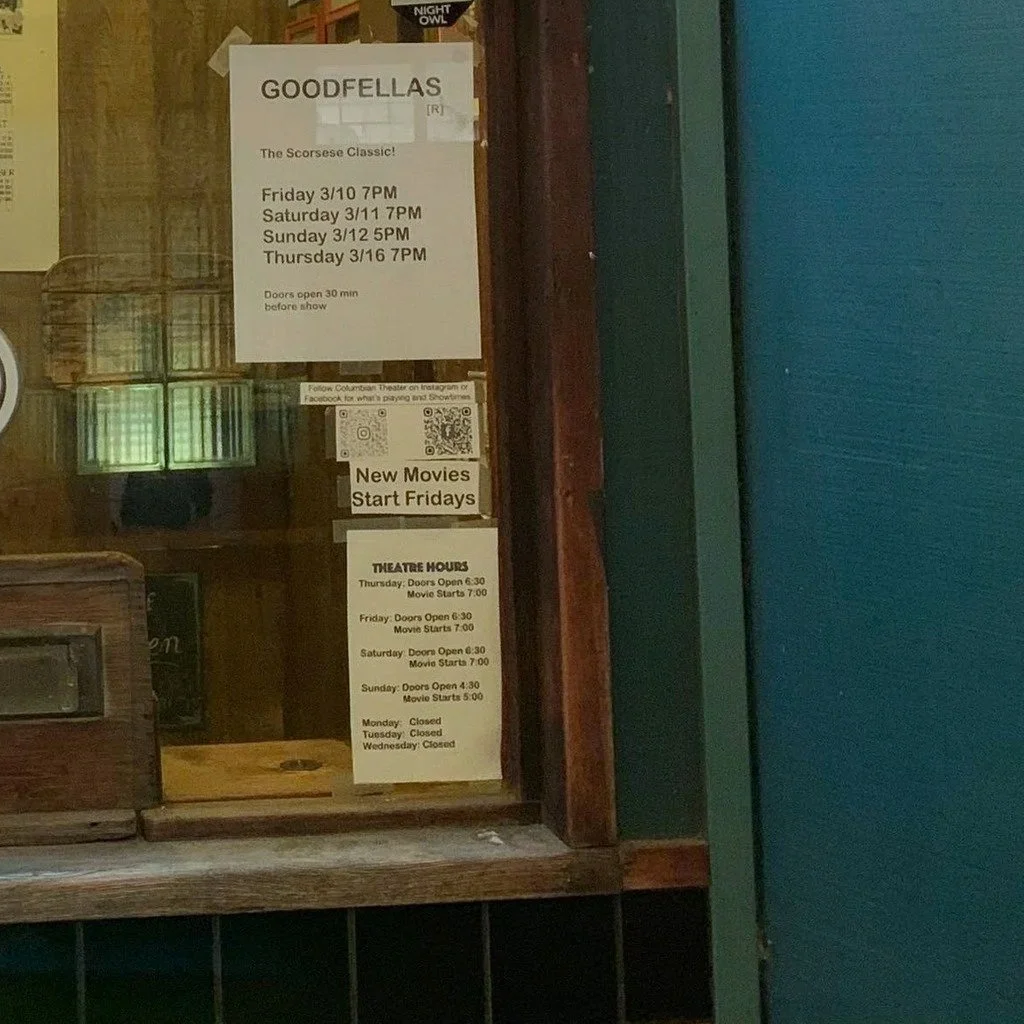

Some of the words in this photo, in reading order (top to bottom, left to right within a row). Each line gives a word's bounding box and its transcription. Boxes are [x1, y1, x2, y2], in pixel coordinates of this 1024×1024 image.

[414, 5, 451, 15] NIGHT
[419, 15, 447, 25] OWL
[261, 77, 441, 99] GOODFELLAS
[261, 147, 283, 158] The
[286, 147, 343, 158] Scorsese
[347, 146, 395, 157] Classic!
[262, 188, 315, 204] Friday
[320, 187, 356, 201] 3/10
[362, 186, 397, 200] 7PM
[263, 208, 339, 225] Saturday
[344, 207, 380, 222] 3/11
[386, 206, 421, 220] 7PM
[263, 229, 327, 245] Sunday
[333, 228, 368, 243] 3/12
[374, 227, 410, 241] 5PM
[263, 250, 344, 267] Thursday
[349, 249, 385, 263] 3/16
[391, 247, 427, 262] 7PM
[264, 290, 295, 299] Doors
[297, 291, 323, 301] open
[325, 289, 337, 298] 30
[340, 289, 359, 297] min
[265, 302, 297, 311] before
[300, 302, 327, 310] show
[335, 384, 376, 392] Columbian
[421, 384, 458, 392] Instagram
[385, 394, 410, 403] playing
[356, 467, 397, 483] New
[404, 466, 470, 482] Movies
[352, 492, 399, 507] Start
[405, 490, 475, 509] Fridays
[372, 563, 424, 573] THEATRE
[427, 562, 468, 572] HOURS
[359, 579, 405, 589] Thursday:
[408, 579, 435, 587] Doors
[438, 578, 463, 587] Open
[465, 577, 485, 585] 6:30
[407, 590, 434, 598] Movie
[437, 589, 465, 598] Starts
[467, 589, 487, 597] 7:00
[394, 613, 422, 622] Doors
[425, 613, 450, 622] Open
[452, 612, 472, 620] 6:30
[394, 625, 421, 634] Movie
[424, 624, 452, 633] Starts
[454, 624, 474, 632] 7:00
[408, 648, 436, 657] Doors
[438, 647, 463, 657] Open
[465, 646, 485, 655] 6:30
[409, 660, 436, 668] Movie
[439, 659, 467, 667] Starts
[469, 658, 489, 666] 7:00
[362, 683, 400, 693] Sunday:
[402, 683, 429, 692] Doors
[432, 682, 457, 692] Open
[459, 681, 480, 689] 4:30
[403, 695, 430, 703] Movie
[433, 694, 461, 702] Starts
[463, 693, 483, 701] 5:00
[409, 717, 442, 726] Closed
[410, 729, 442, 737] Closed
[422, 740, 455, 749] Closed
